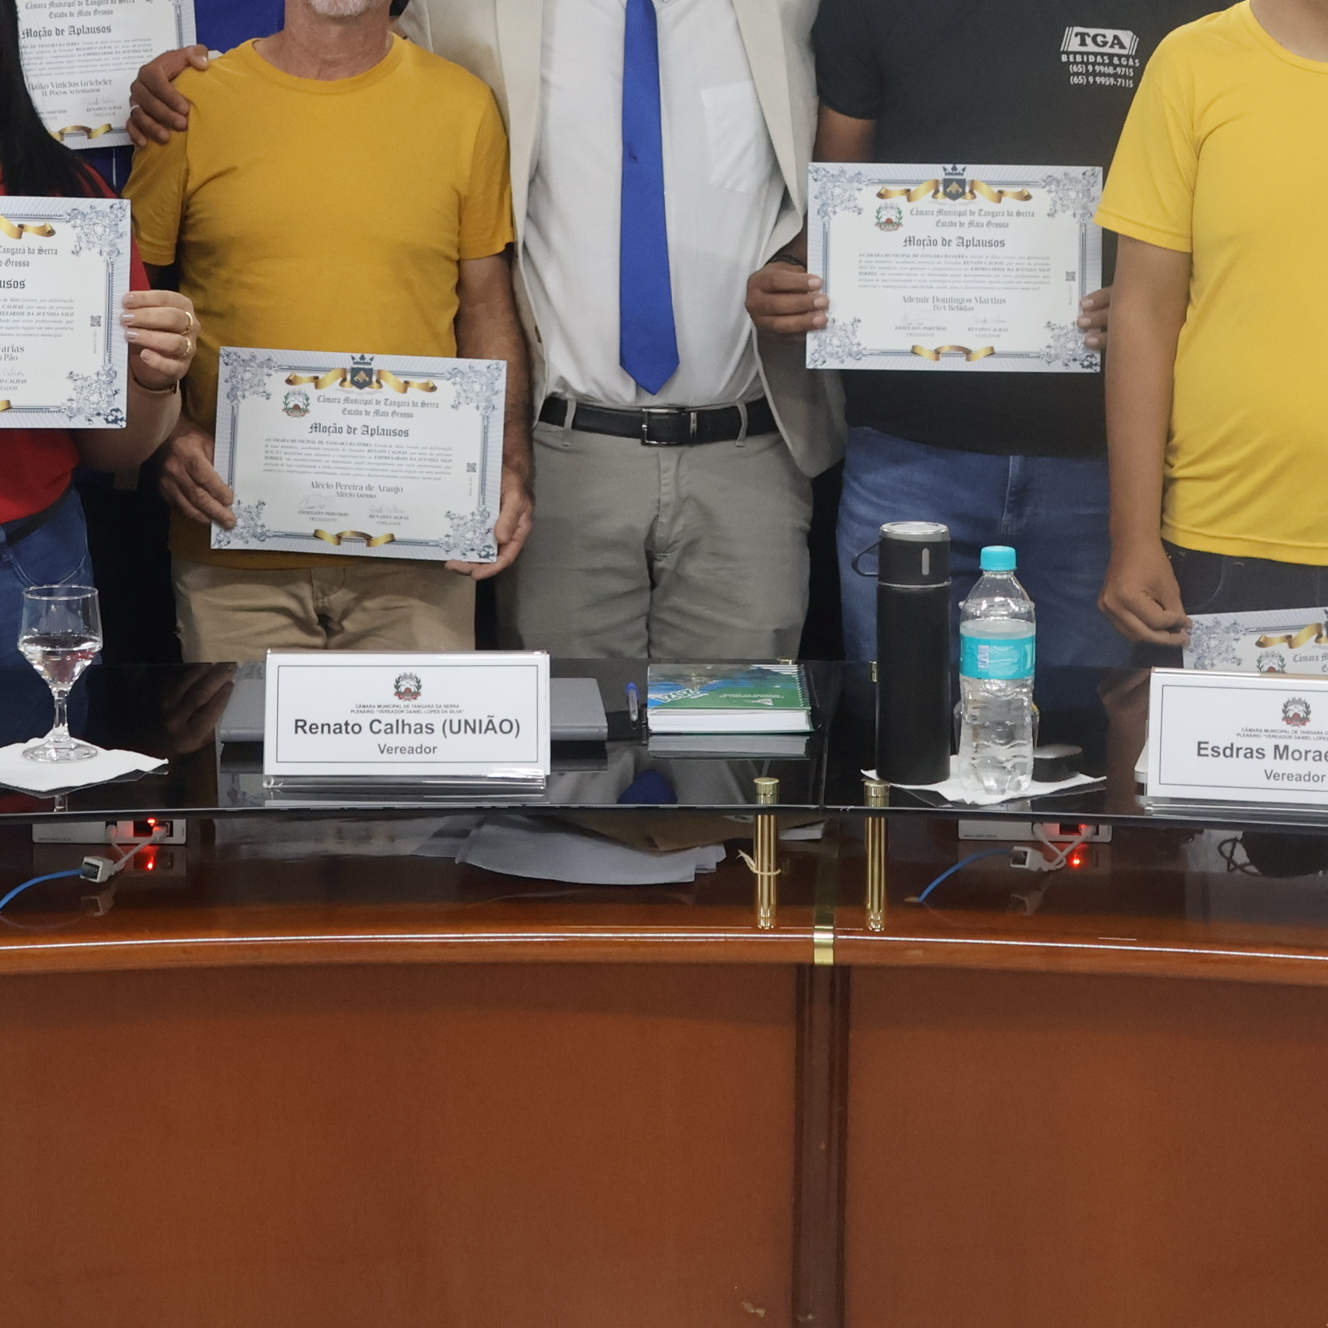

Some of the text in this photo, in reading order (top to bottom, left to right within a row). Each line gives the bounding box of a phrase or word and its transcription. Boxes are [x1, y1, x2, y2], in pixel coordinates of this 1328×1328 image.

[22, 24, 112, 40] Moção de Aplausos
[1074, 32, 1127, 50] TGA
[1061, 54, 1109, 63] BEBIDAS
[1070, 64, 1086, 73] (65)
[1070, 75, 1086, 85] (65)
[1088, 76, 1093, 84] 9
[903, 235, 1006, 250] Moção de Aplausos
[27, 246, 35, 255] da
[37, 246, 58, 256] Serra
[309, 422, 410, 438] Moção de Aplausos
[294, 714, 521, 739] Renato Calhas (UNIÃO)
[377, 743, 438, 755] Vereador
[1196, 740, 1266, 760] Esdras
[1264, 768, 1326, 784] Vereador
